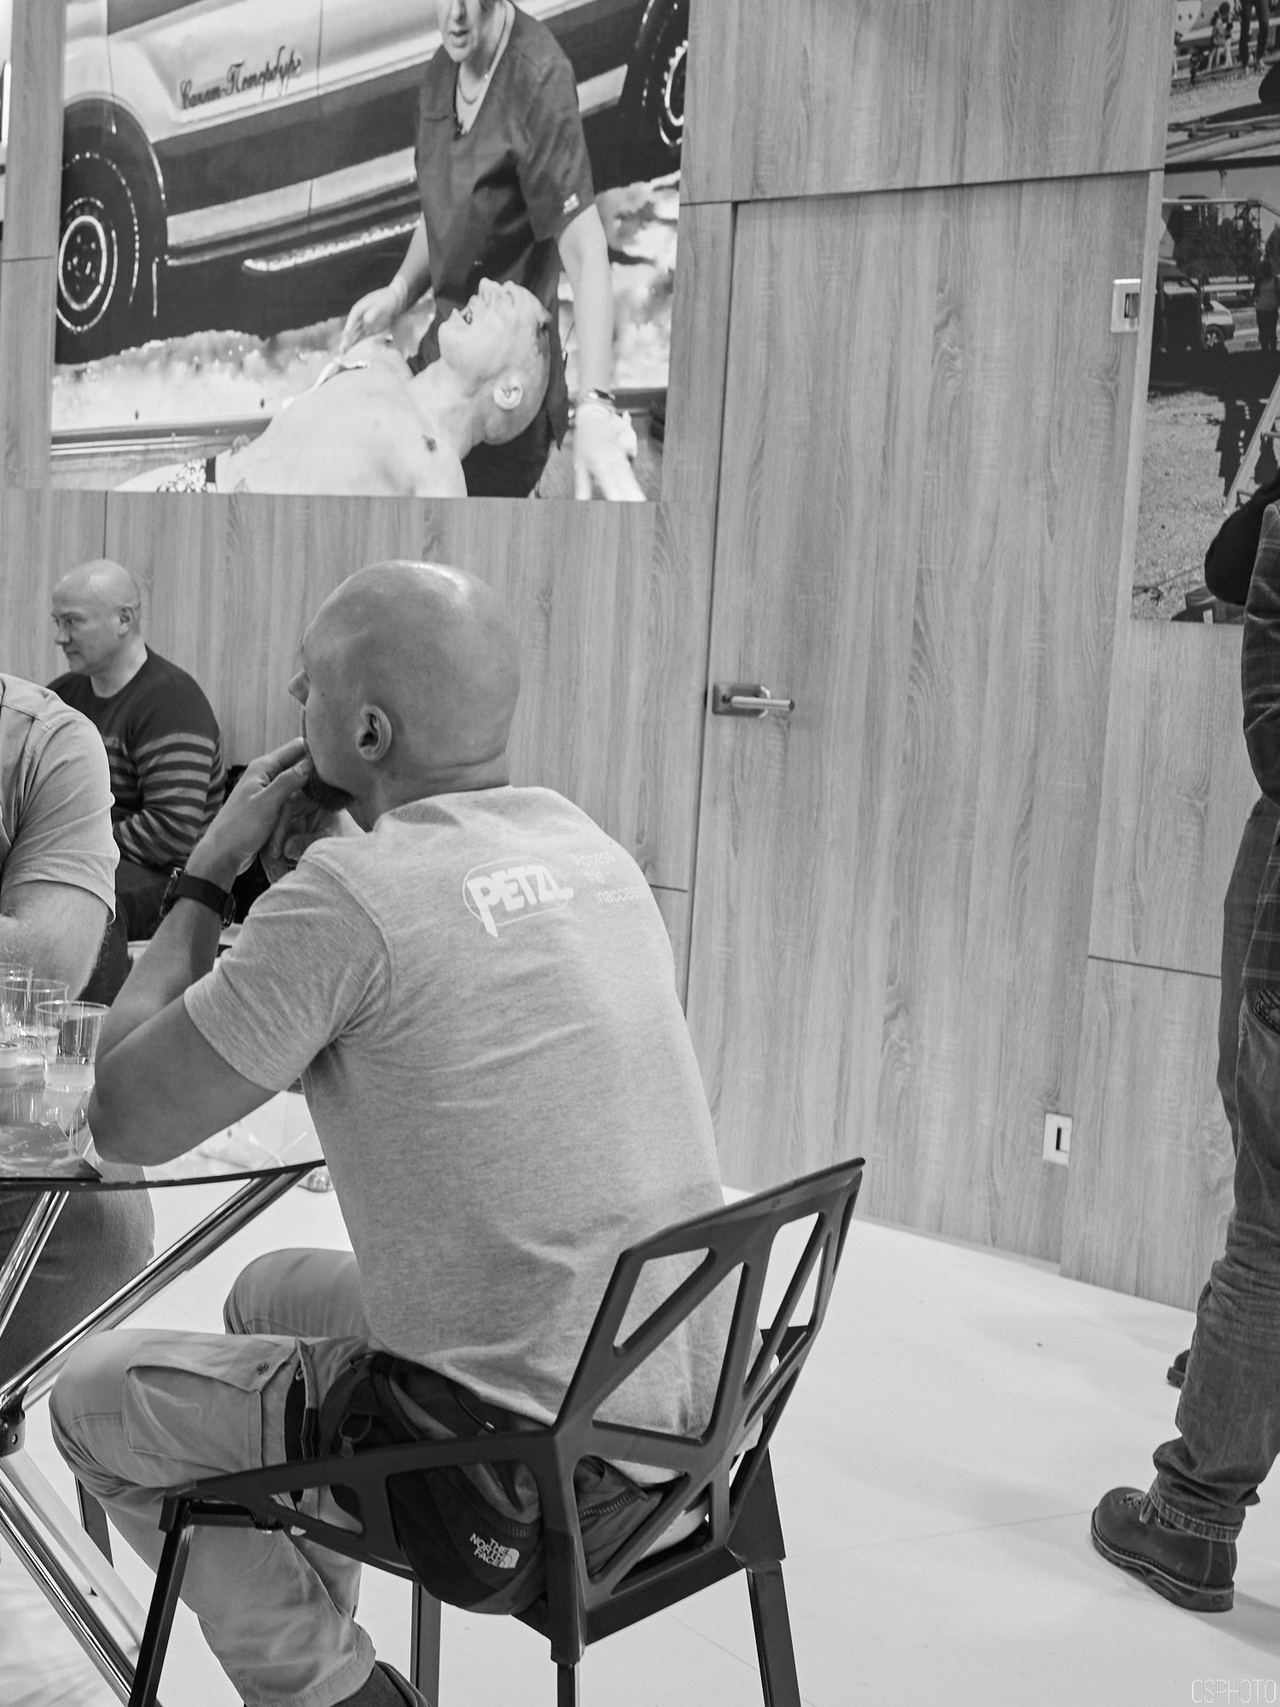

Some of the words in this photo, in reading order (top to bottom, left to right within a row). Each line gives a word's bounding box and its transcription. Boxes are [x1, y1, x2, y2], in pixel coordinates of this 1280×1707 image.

[467, 864, 574, 938] PETZL
[469, 1532, 505, 1562] NORTH
[474, 1547, 500, 1568] FACE
